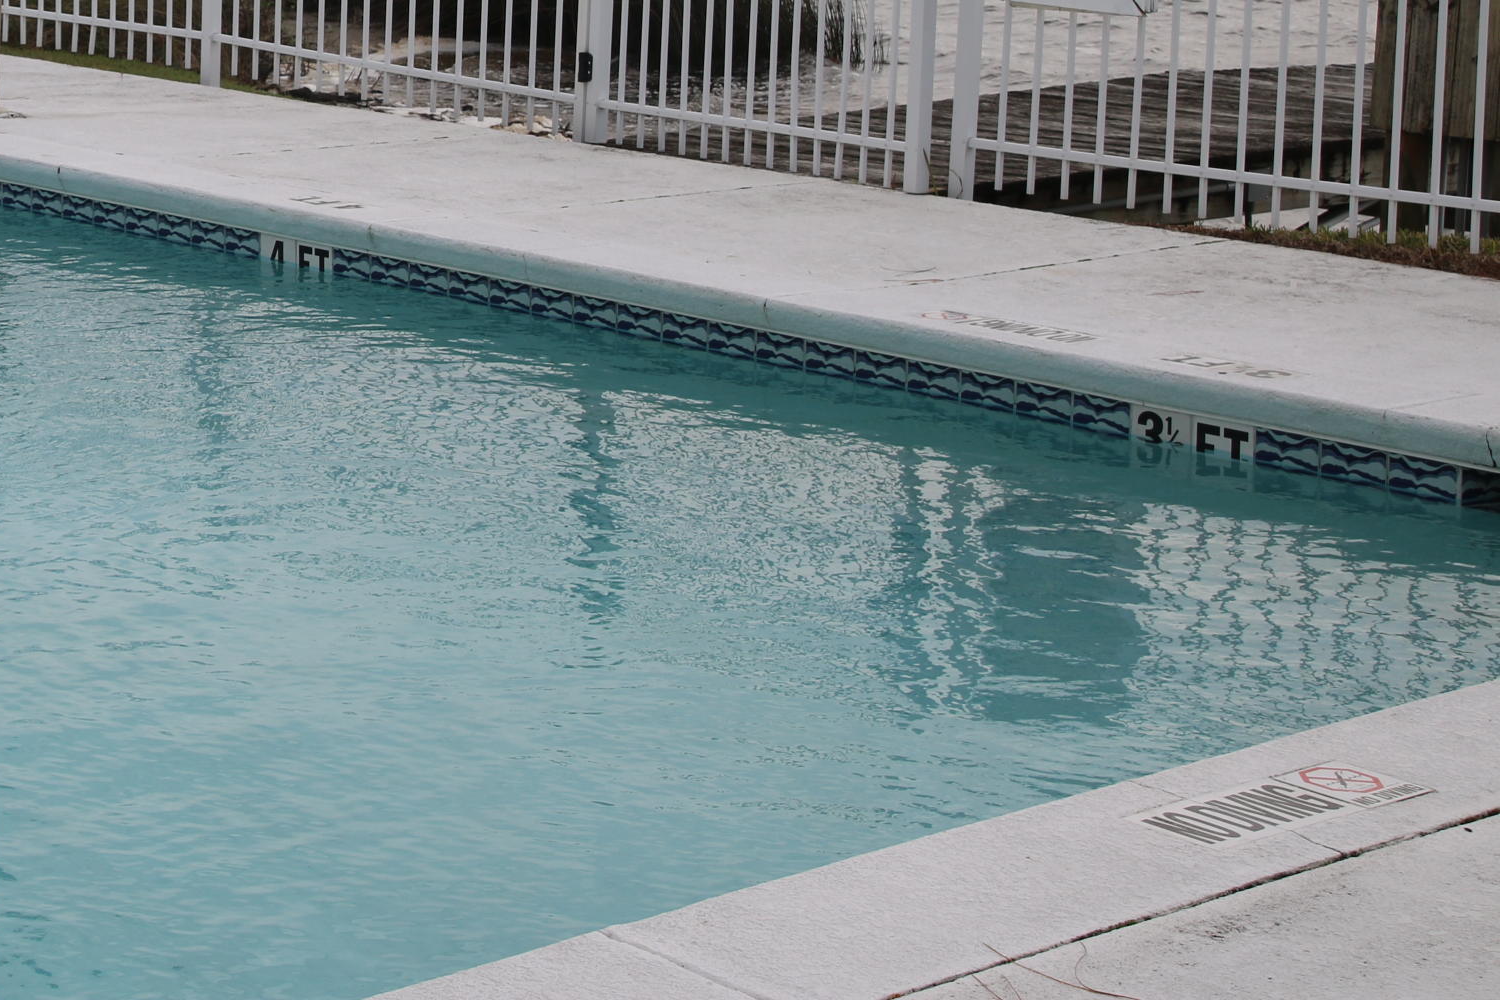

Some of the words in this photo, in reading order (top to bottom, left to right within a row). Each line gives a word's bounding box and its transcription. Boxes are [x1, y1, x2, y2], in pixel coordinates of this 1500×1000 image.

[298, 245, 330, 273] FT
[1195, 422, 1250, 460] FT
[1183, 784, 1345, 832] DIVING
[1141, 812, 1241, 844] NO
